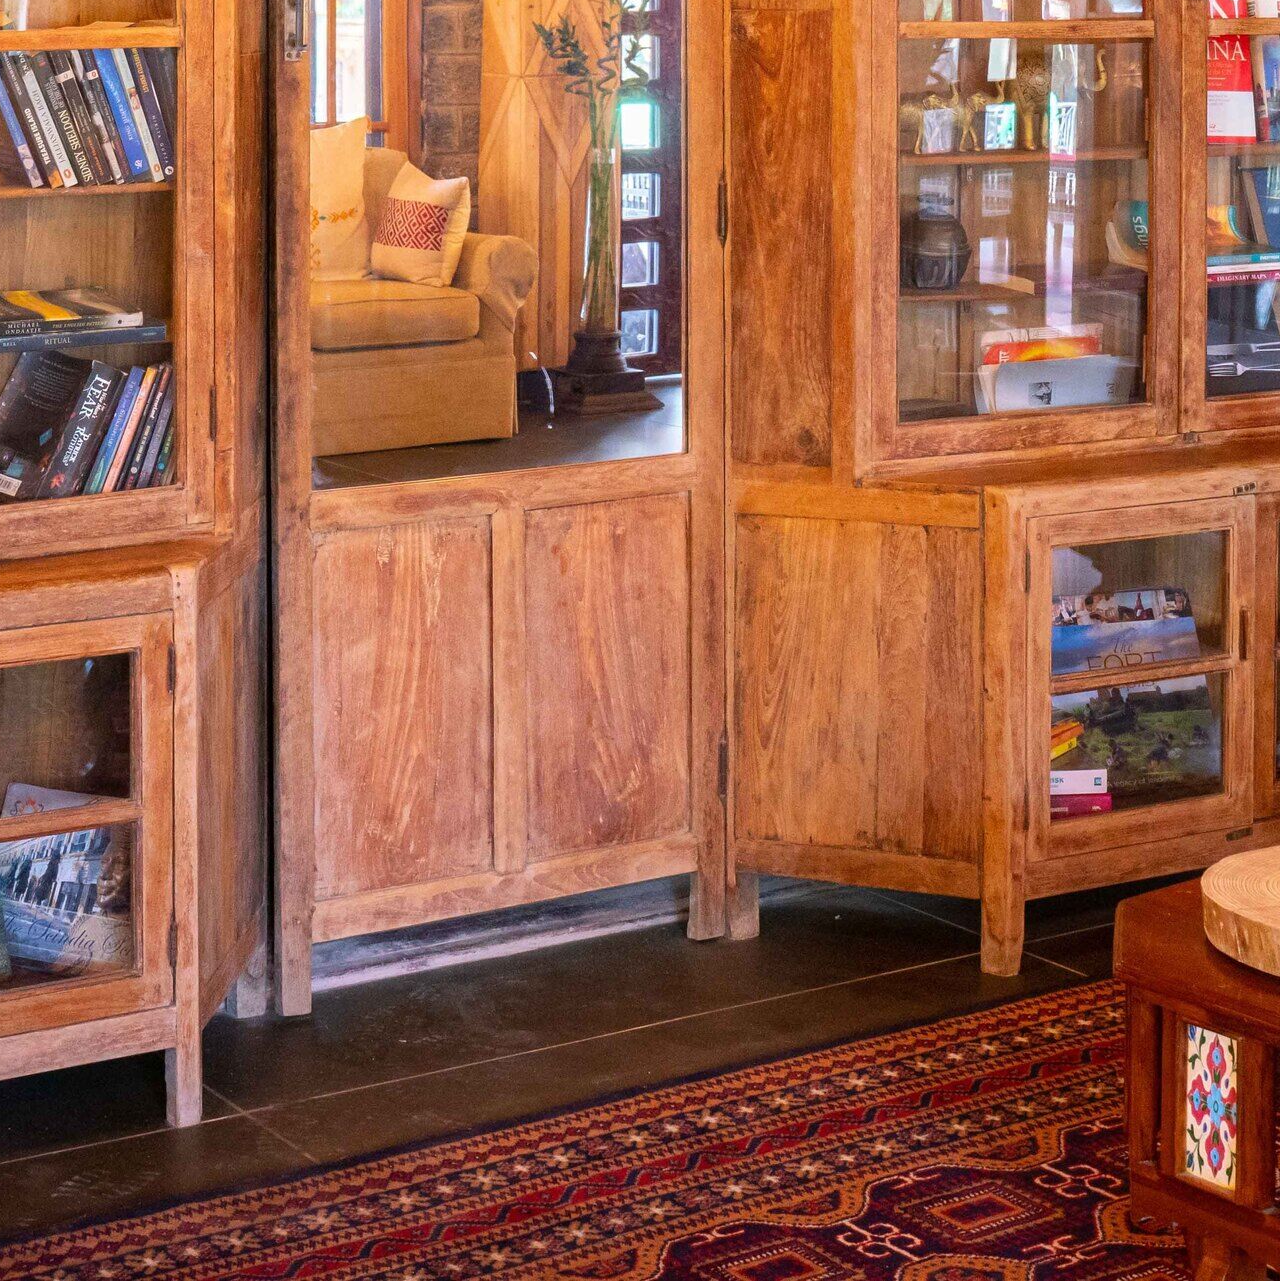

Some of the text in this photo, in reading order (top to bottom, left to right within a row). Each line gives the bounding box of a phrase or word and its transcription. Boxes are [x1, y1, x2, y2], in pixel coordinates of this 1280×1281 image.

[23, 107, 51, 166] TREASURE ISLAND
[58, 110, 94, 183] SIDNEY SHELDON
[1132, 216, 1148, 247] ings
[1216, 274, 1249, 282] IMAGINARY
[4, 327, 43, 336] ONDAATJE
[7, 322, 41, 330] MICHAEL
[44, 336, 71, 346] RITUAL
[82, 373, 111, 420] FEAR
[67, 426, 92, 463] PATRICK
[1087, 650, 1162, 670] FORT
[1051, 776, 1064, 784] ISK
